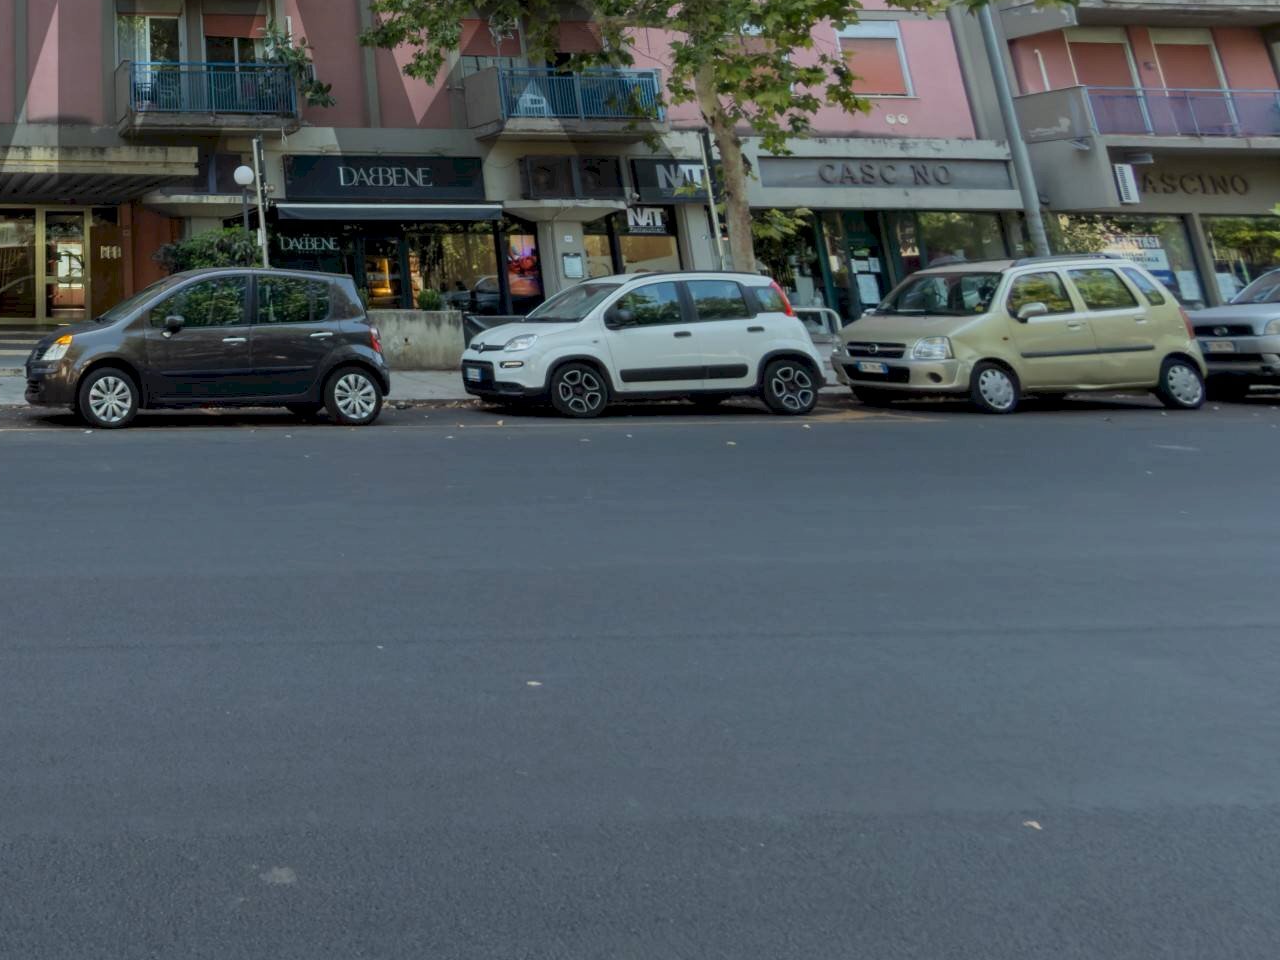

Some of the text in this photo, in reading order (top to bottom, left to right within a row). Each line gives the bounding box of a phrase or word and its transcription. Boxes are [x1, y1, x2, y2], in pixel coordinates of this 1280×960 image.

[655, 164, 706, 189] NAT
[1141, 174, 1250, 195] ASCINO
[627, 207, 665, 227] NAT
